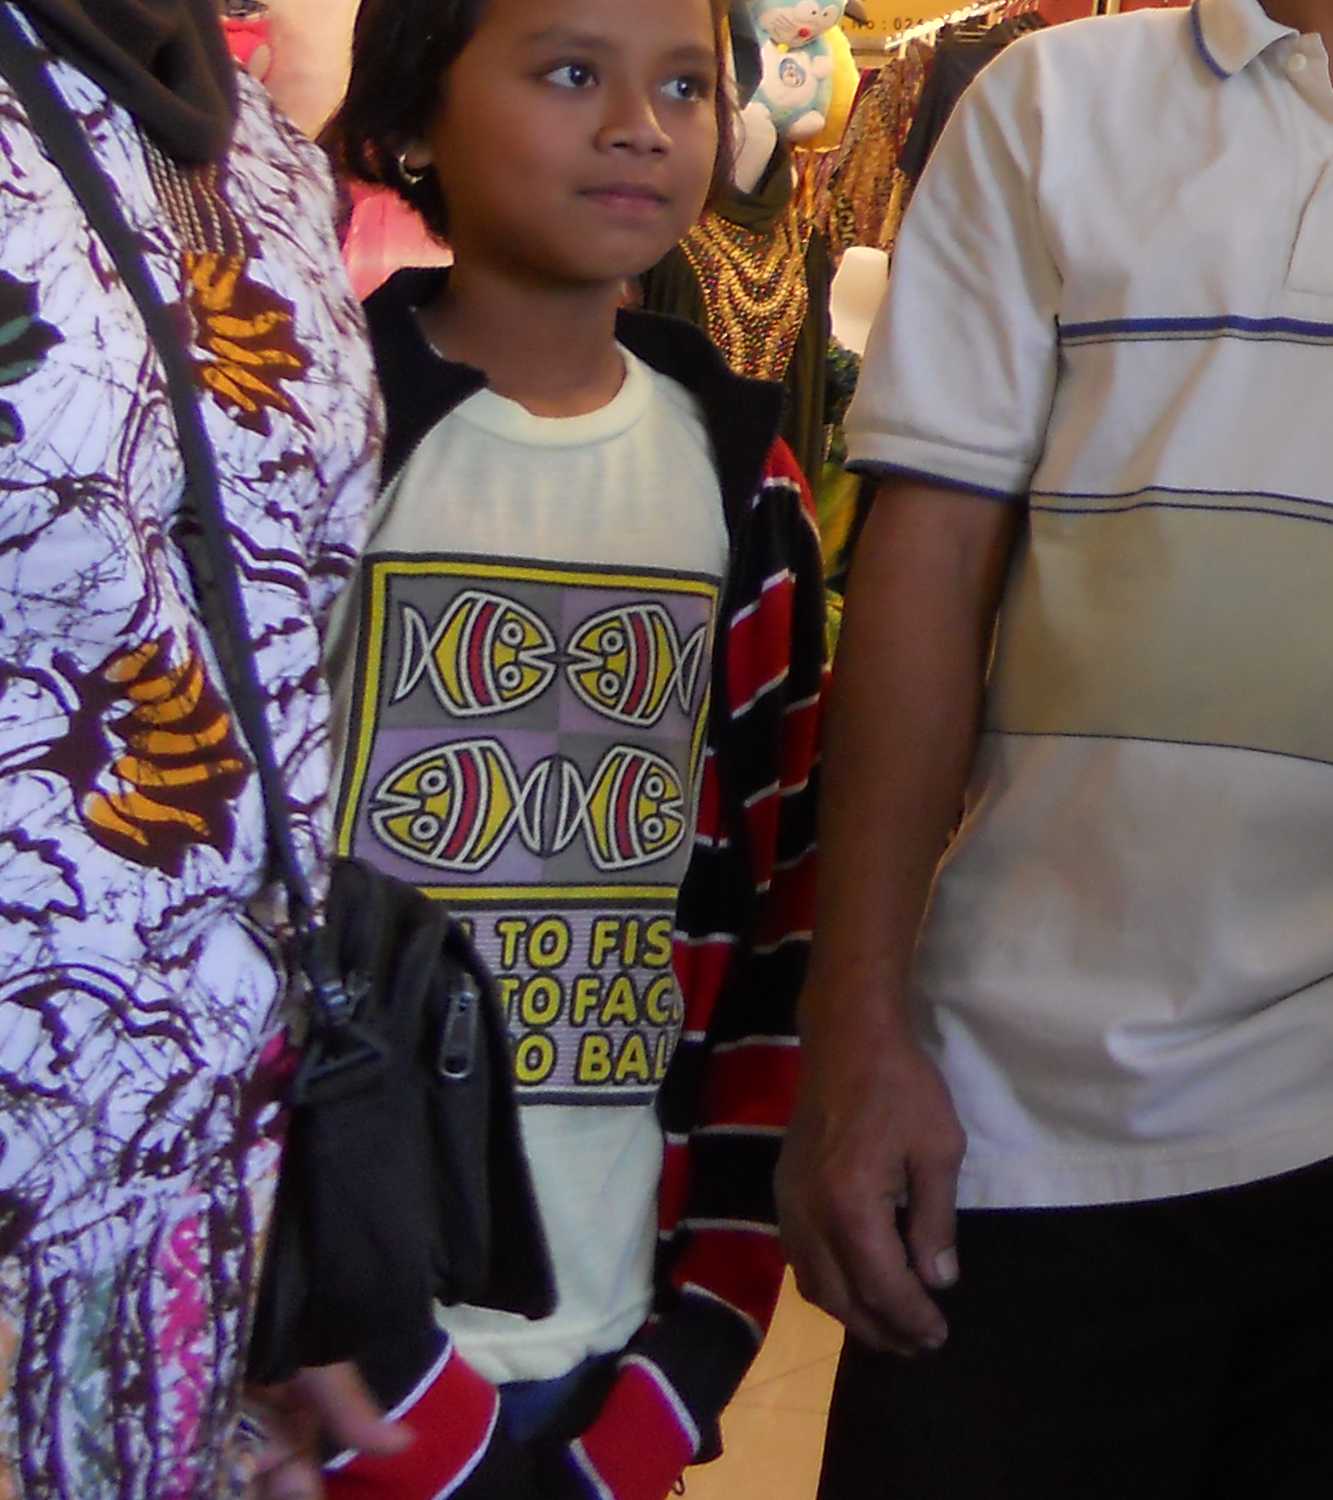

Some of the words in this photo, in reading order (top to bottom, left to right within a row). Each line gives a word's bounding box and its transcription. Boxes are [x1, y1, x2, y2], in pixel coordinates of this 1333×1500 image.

[497, 916, 571, 969] TO
[589, 916, 673, 968] FIS
[571, 974, 683, 1026] FAC
[514, 1033, 557, 1084] O
[577, 1031, 668, 1084] BAL
